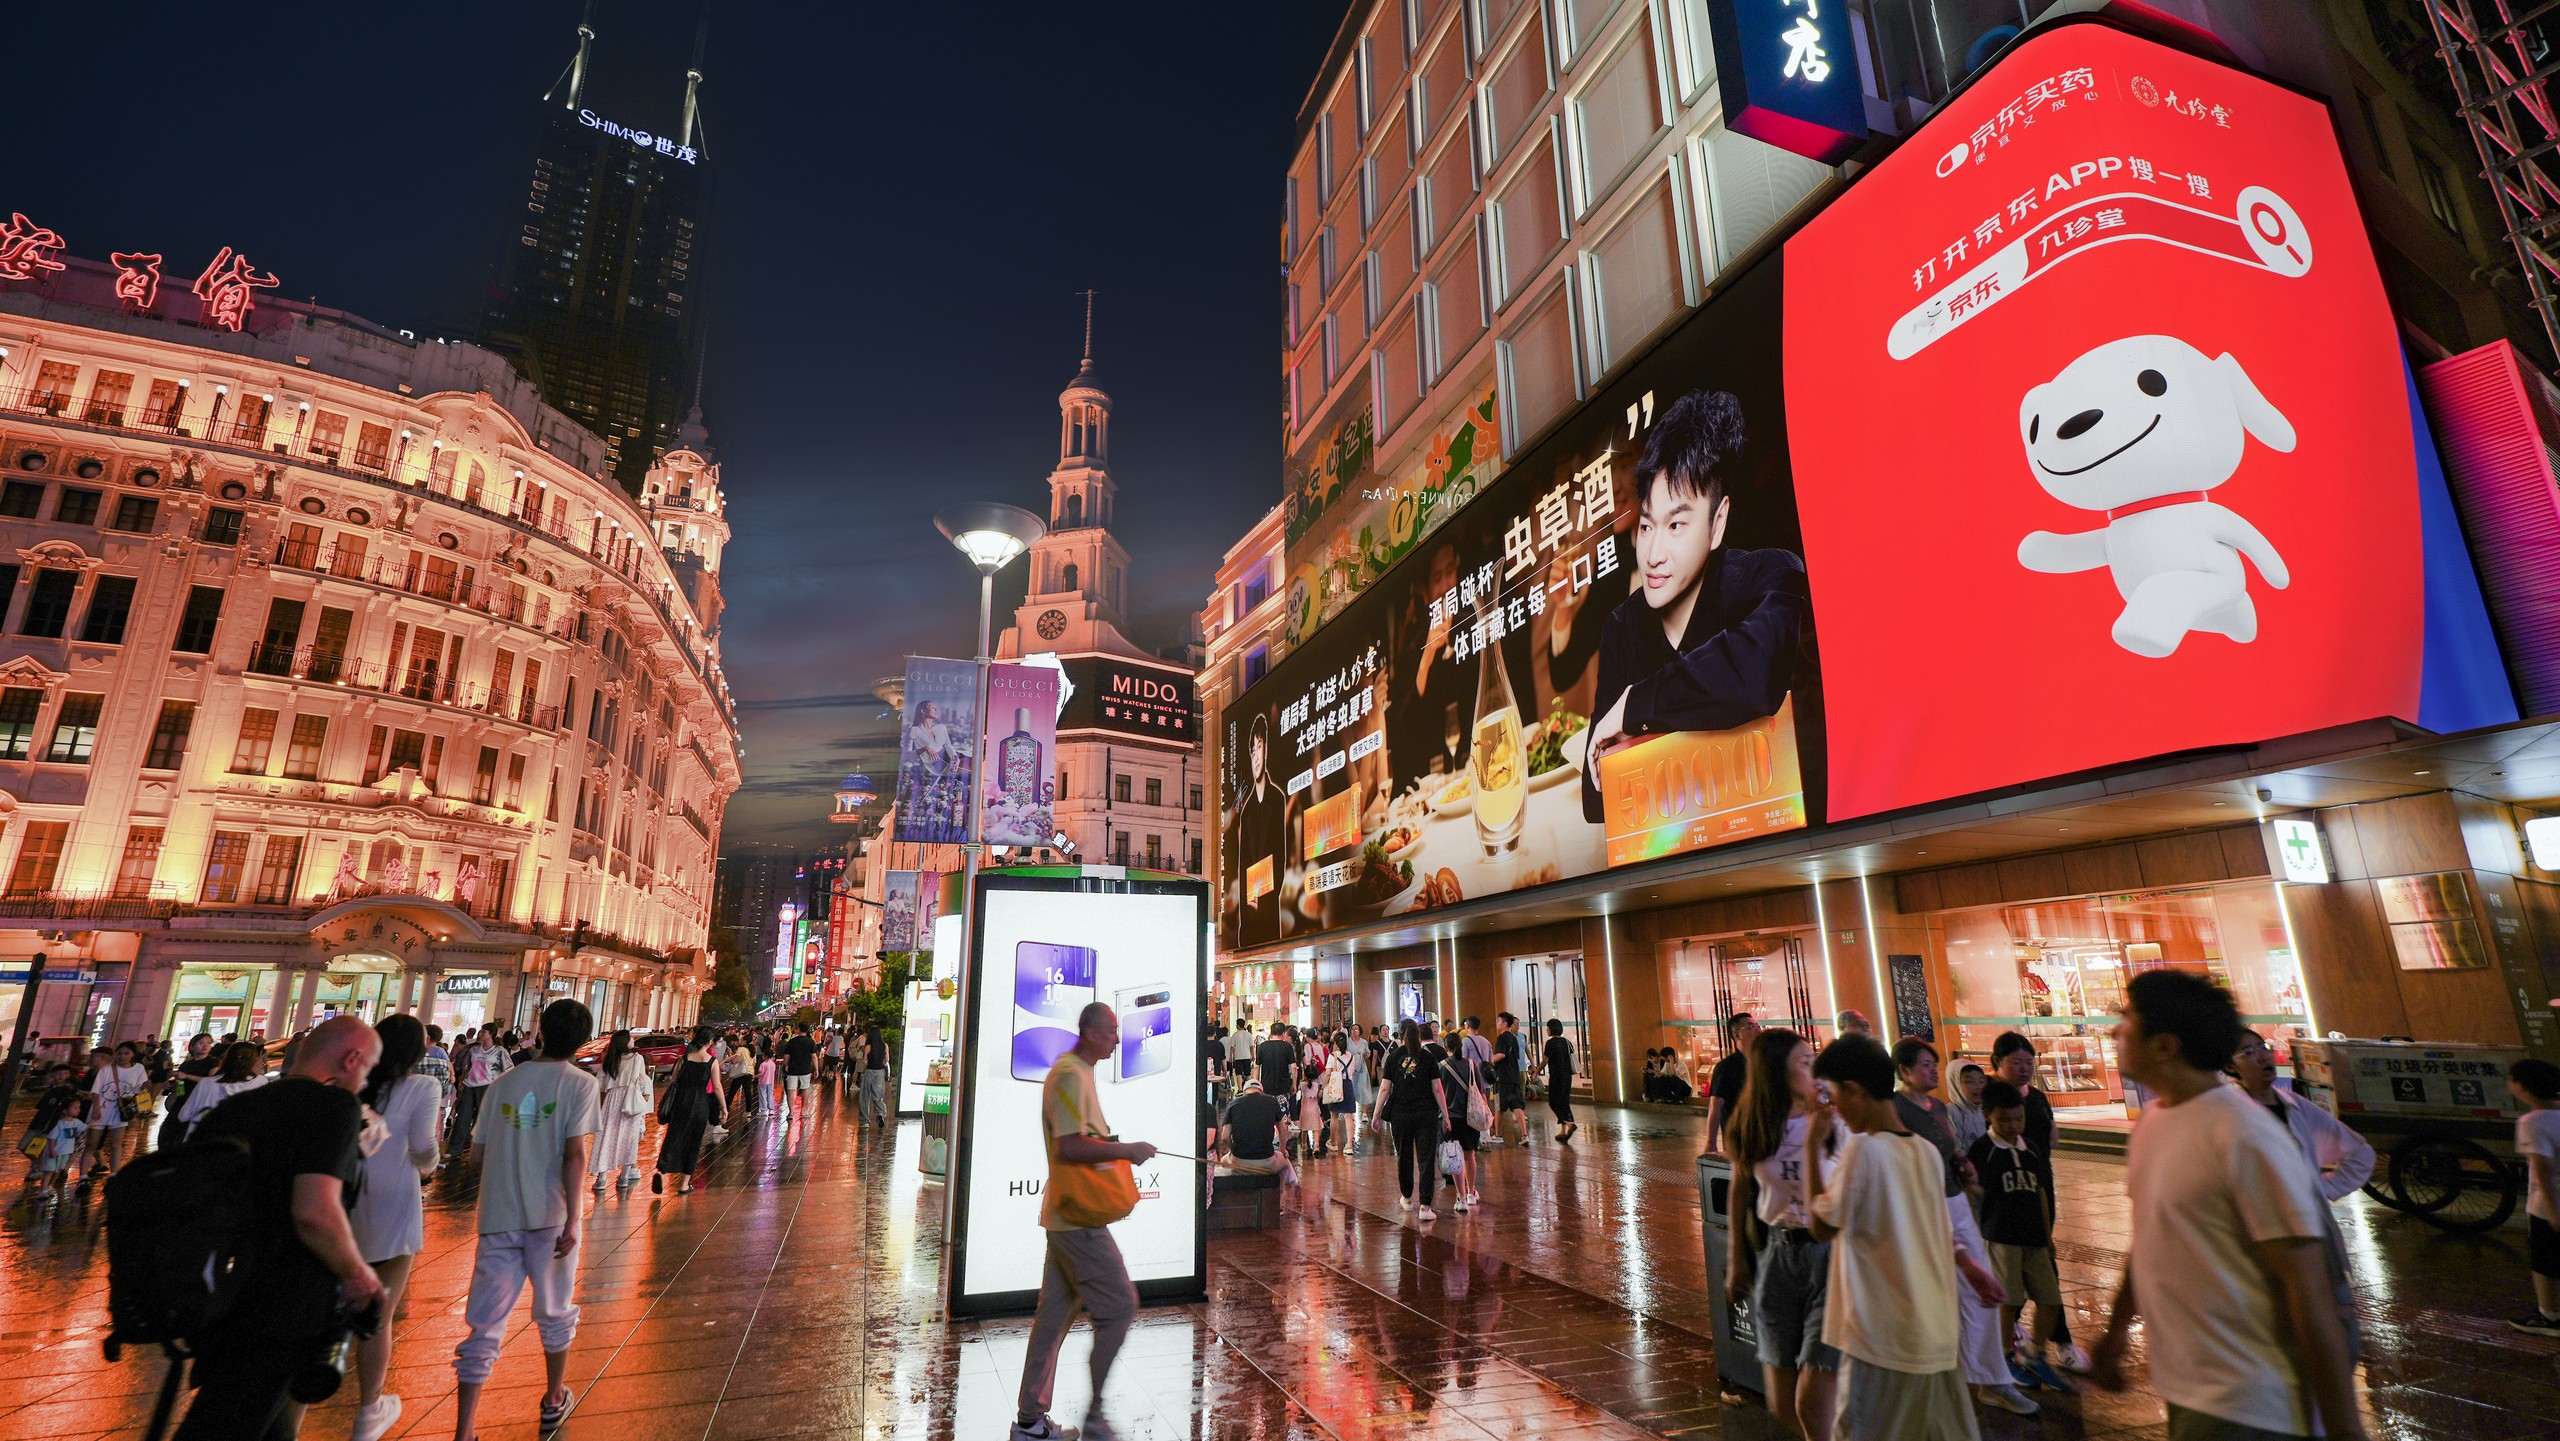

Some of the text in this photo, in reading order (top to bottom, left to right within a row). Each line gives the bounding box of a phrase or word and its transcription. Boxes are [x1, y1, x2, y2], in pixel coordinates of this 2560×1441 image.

[1969, 67, 2095, 154] 京东买药
[1974, 91, 2098, 165] 便宜又放心
[2164, 90, 2231, 129] 九珍堂
[578, 108, 697, 165] SHIMAO 世茂
[2038, 208, 2126, 257] 九珍堂
[1948, 271, 2001, 321] 京东
[1428, 451, 1615, 630] 酒局碰杯 虫草酒
[1453, 534, 1619, 665] 体面藏在每一口里
[910, 671, 972, 687] GUCCI
[921, 683, 959, 694] FLORA
[994, 677, 1053, 692] GUCCI
[1005, 691, 1041, 700] FLORA
[1101, 695, 1121, 703] SWISS
[1123, 699, 1152, 709] WATCHES
[1153, 704, 1173, 713] SINCE
[1105, 706, 1184, 729] 瑞士美度表
[1280, 693, 1309, 737] 懂局者
[1296, 684, 1374, 757] 太空舱冬虫夏草
[1619, 730, 1774, 828] 5000
[1045, 966, 1064, 984] 16
[90, 997, 112, 1050] 周生生
[1141, 1025, 1153, 1039] 16
[2386, 1059, 2499, 1077] 垃圾分类收集
[1009, 1179, 1044, 1197] HU
[2002, 1169, 2037, 1193] GAP
